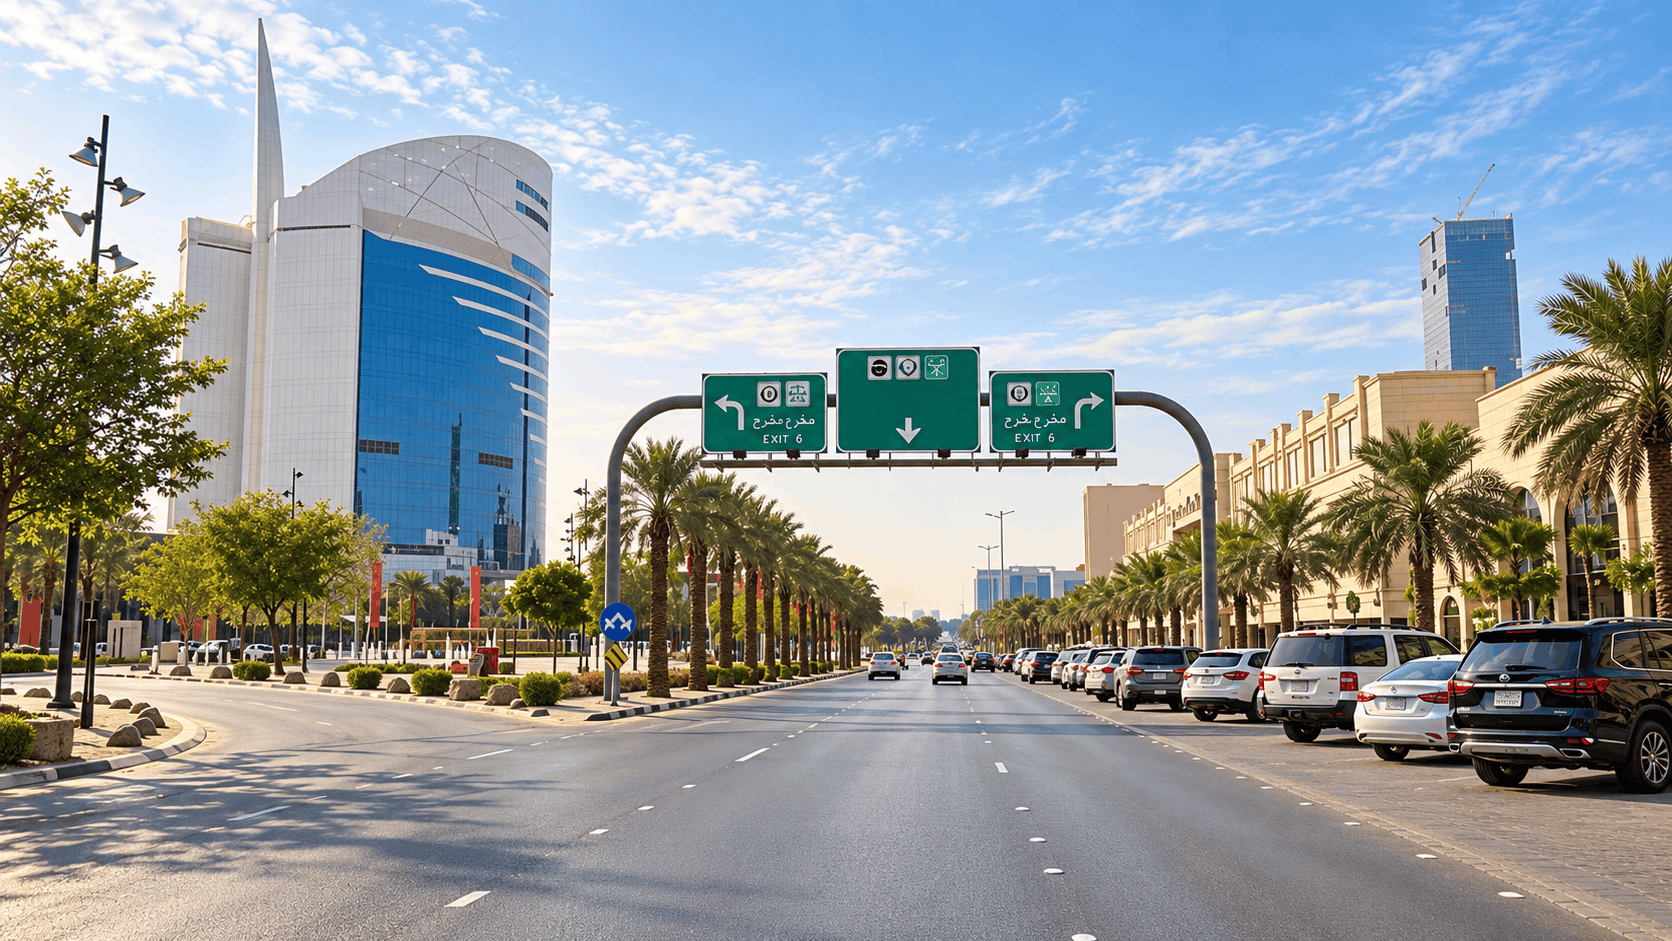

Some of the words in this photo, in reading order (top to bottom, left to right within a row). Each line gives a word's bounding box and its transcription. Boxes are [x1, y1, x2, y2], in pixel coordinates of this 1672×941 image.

[763, 434, 789, 444] EXIT
[796, 433, 803, 444] 6
[1014, 433, 1040, 443] EXIT
[1048, 432, 1055, 443] 6
